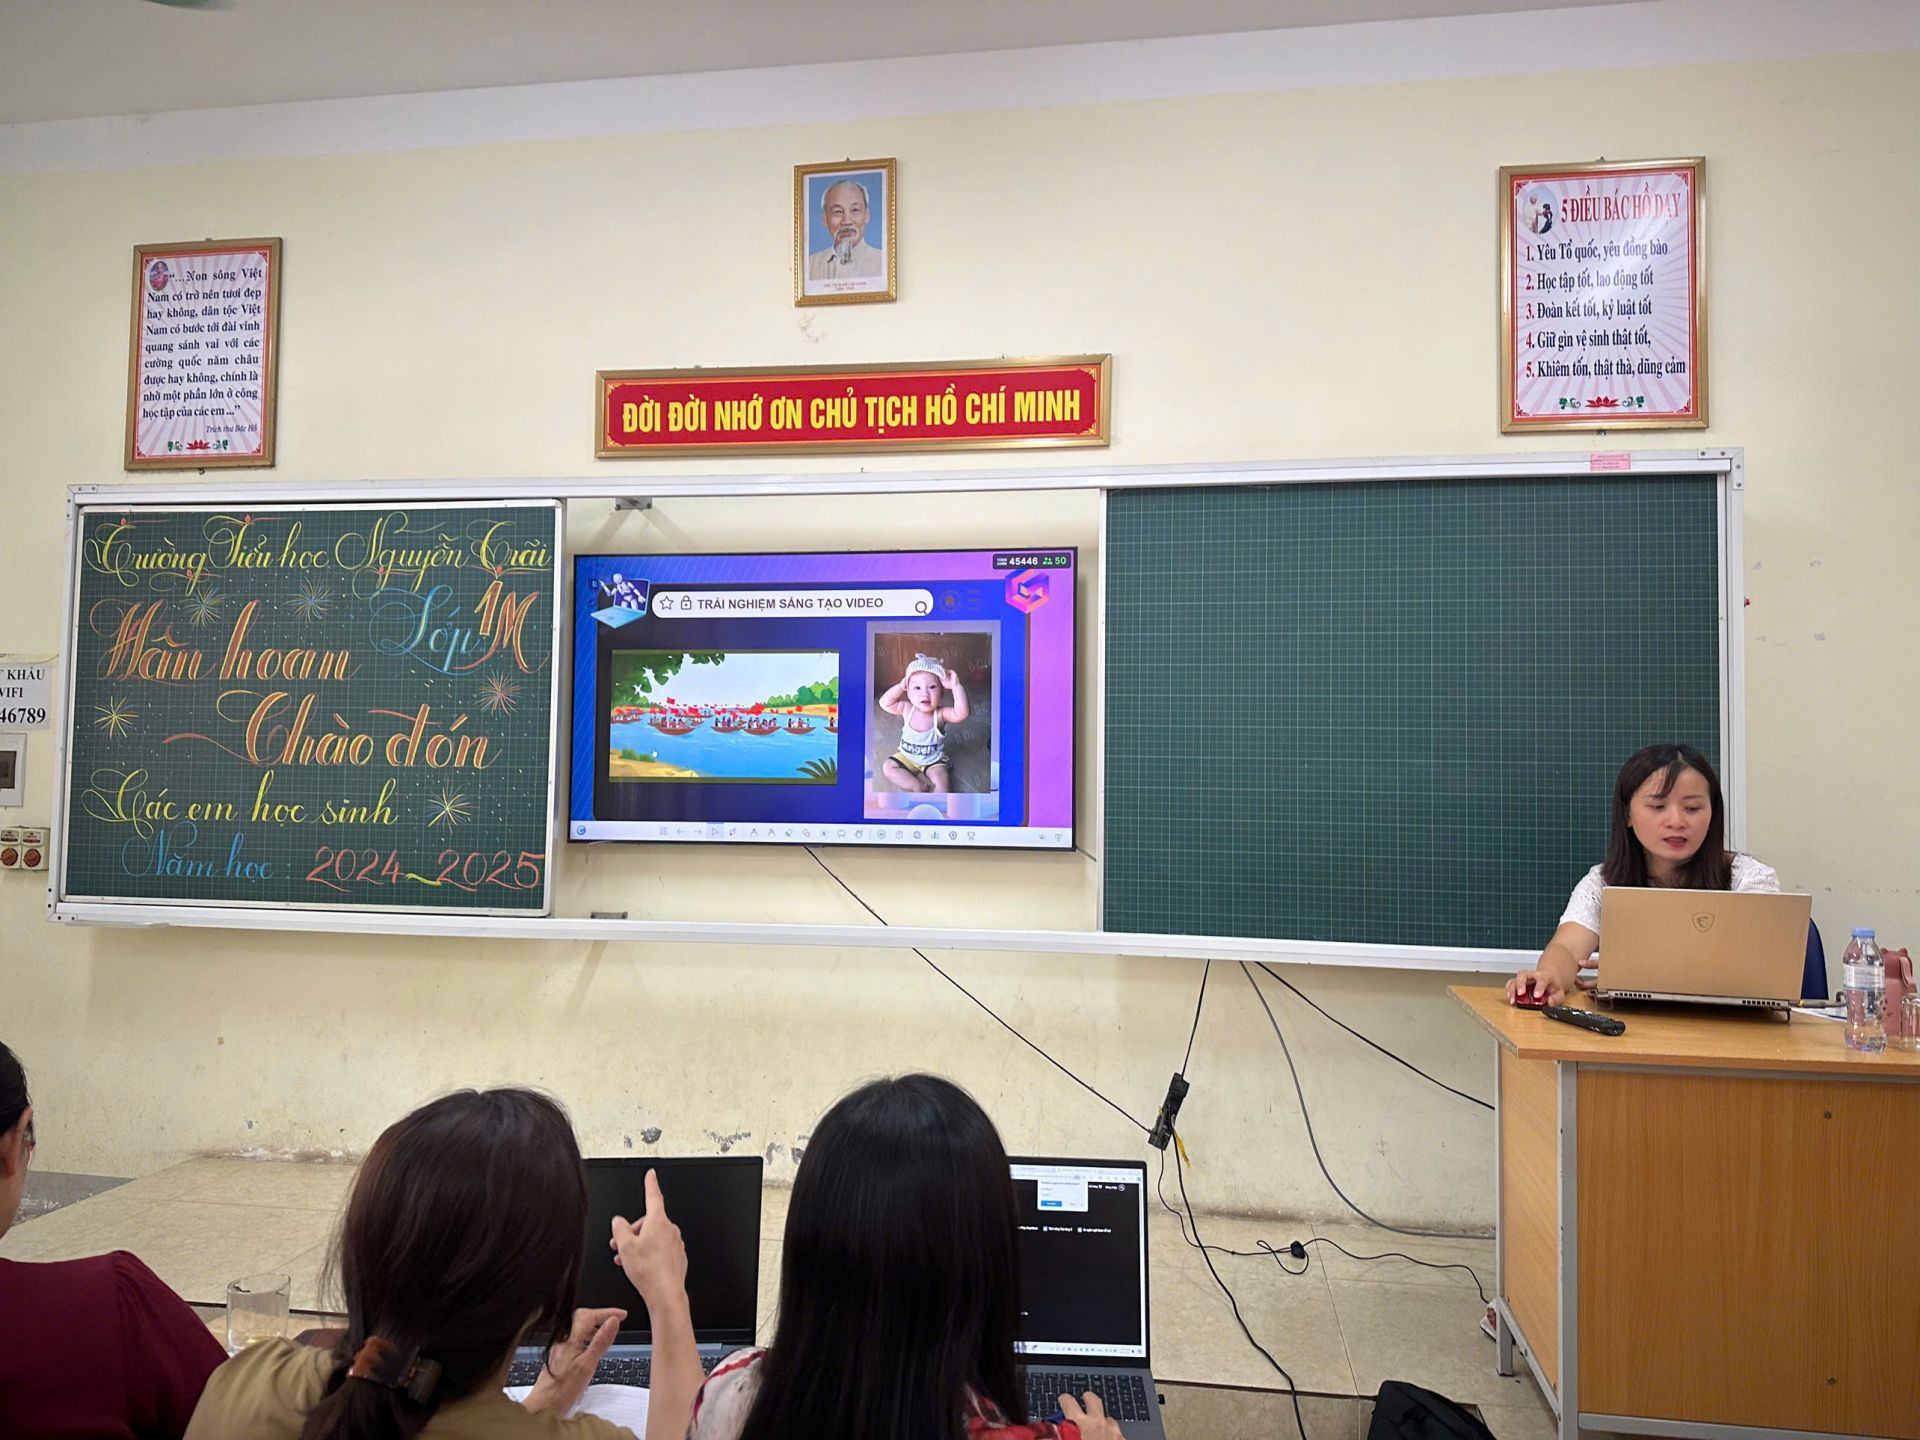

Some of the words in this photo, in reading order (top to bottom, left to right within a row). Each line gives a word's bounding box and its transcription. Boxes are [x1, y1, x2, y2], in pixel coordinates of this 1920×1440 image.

[1561, 198, 1568, 223] 5
[1571, 185, 1600, 223] ĐIỀU
[1604, 188, 1630, 221] BÁC
[1632, 181, 1650, 219] HỒ
[1651, 192, 1681, 224] DẠY
[1526, 246, 1534, 262] 1.
[1536, 244, 1556, 261] Yêu
[1559, 239, 1572, 259] Tổ
[1574, 239, 1601, 263] quốc,
[1603, 240, 1621, 261] yêu
[1623, 236, 1648, 260] đồng
[1650, 239, 1668, 255] bào
[213, 269, 236, 280] sông
[242, 268, 262, 280] Việt
[1526, 274, 1534, 290] 2.
[1537, 272, 1557, 293] Học
[1559, 272, 1574, 293] tập
[1577, 268, 1594, 289] tốt,
[1596, 271, 1611, 288] lao
[1613, 272, 1637, 290] động
[1640, 265, 1654, 285] tốt
[148, 292, 169, 303] Nam
[172, 291, 182, 301] có
[202, 289, 219, 299] nên
[222, 288, 241, 299] tươi
[244, 287, 261, 300] đẹp
[147, 309, 162, 320] hay
[167, 307, 198, 318] không,
[201, 305, 219, 316] dân
[223, 305, 237, 317] tộc
[241, 303, 261, 317] Việt
[1526, 303, 1534, 319] 3.
[1537, 302, 1562, 319] Đoàn
[1565, 297, 1581, 317] kết
[1583, 296, 1600, 319] tốt,
[1602, 299, 1614, 320] kỷ
[1617, 298, 1636, 319] luật
[1638, 295, 1652, 314] tốt
[146, 325, 168, 335] Nam
[170, 323, 180, 334] có
[183, 323, 205, 334] bước
[207, 322, 220, 333] tới
[221, 321, 236, 332] đài
[239, 320, 260, 331] vinh
[1526, 332, 1535, 349] 4.
[1537, 331, 1556, 348] Giữ
[1558, 330, 1573, 351] gìn
[1576, 330, 1587, 350] vệ
[1589, 329, 1609, 346] sinh
[1612, 328, 1632, 349] thật
[1634, 324, 1651, 347] tốt,
[145, 343, 174, 354] quang
[178, 339, 200, 350] sánh
[205, 338, 219, 349] vai
[225, 338, 238, 349] với
[244, 337, 259, 347] các
[144, 358, 173, 369] cường
[178, 354, 202, 369] quốc
[207, 355, 229, 366] năm
[234, 353, 259, 365] châu
[1526, 361, 1535, 377] 5.
[1537, 361, 1570, 377] Khiêm
[1573, 357, 1591, 378] tốn,
[1593, 358, 1613, 380] thật
[1616, 358, 1635, 377] thà,
[1637, 358, 1662, 378] dũng
[1665, 356, 1686, 374] cảm
[144, 375, 166, 387] được
[168, 374, 184, 386] hay
[186, 372, 218, 384] không,
[220, 371, 247, 382] chính
[249, 370, 258, 381] là
[143, 391, 160, 401] nhờ
[163, 390, 181, 403] một
[183, 387, 207, 402] phần
[209, 388, 224, 399] lớn
[235, 387, 258, 399] công
[143, 408, 159, 420] học
[160, 407, 175, 420] tập
[176, 406, 192, 417] của
[194, 405, 210, 416] các
[622, 394, 661, 433] ĐỜI
[668, 393, 706, 432] ĐỜI
[714, 393, 763, 431] NHỚ
[770, 396, 802, 430] ƠN
[810, 386, 857, 430] CHỦ
[864, 394, 917, 434] TỊCH
[925, 383, 958, 426] HỒ
[965, 385, 1006, 425] CHÍ
[1014, 389, 1081, 422] MINH
[84, 522, 210, 597] Trường
[203, 515, 272, 569] Tiểu
[278, 520, 330, 573] học
[335, 511, 469, 600] Nguyễn
[466, 519, 552, 578] Trãi
[1009, 557, 1038, 566] 45446
[1055, 556, 1067, 565] 50
[728, 599, 776, 612] NGHIỆM
[779, 596, 813, 609] SÁNG
[817, 598, 842, 610] TẠO
[845, 598, 884, 608] VIDEO
[220, 599, 361, 681] hoan
[369, 584, 481, 676] Lớp
[0, 707, 46, 723] 46789
[216, 689, 374, 767] Chào
[368, 703, 502, 769] đón
[82, 768, 181, 839] Các
[186, 800, 239, 821] em
[252, 770, 308, 826] học
[318, 778, 399, 825] sinh
[122, 821, 214, 878] Năm
[224, 832, 274, 884] học
